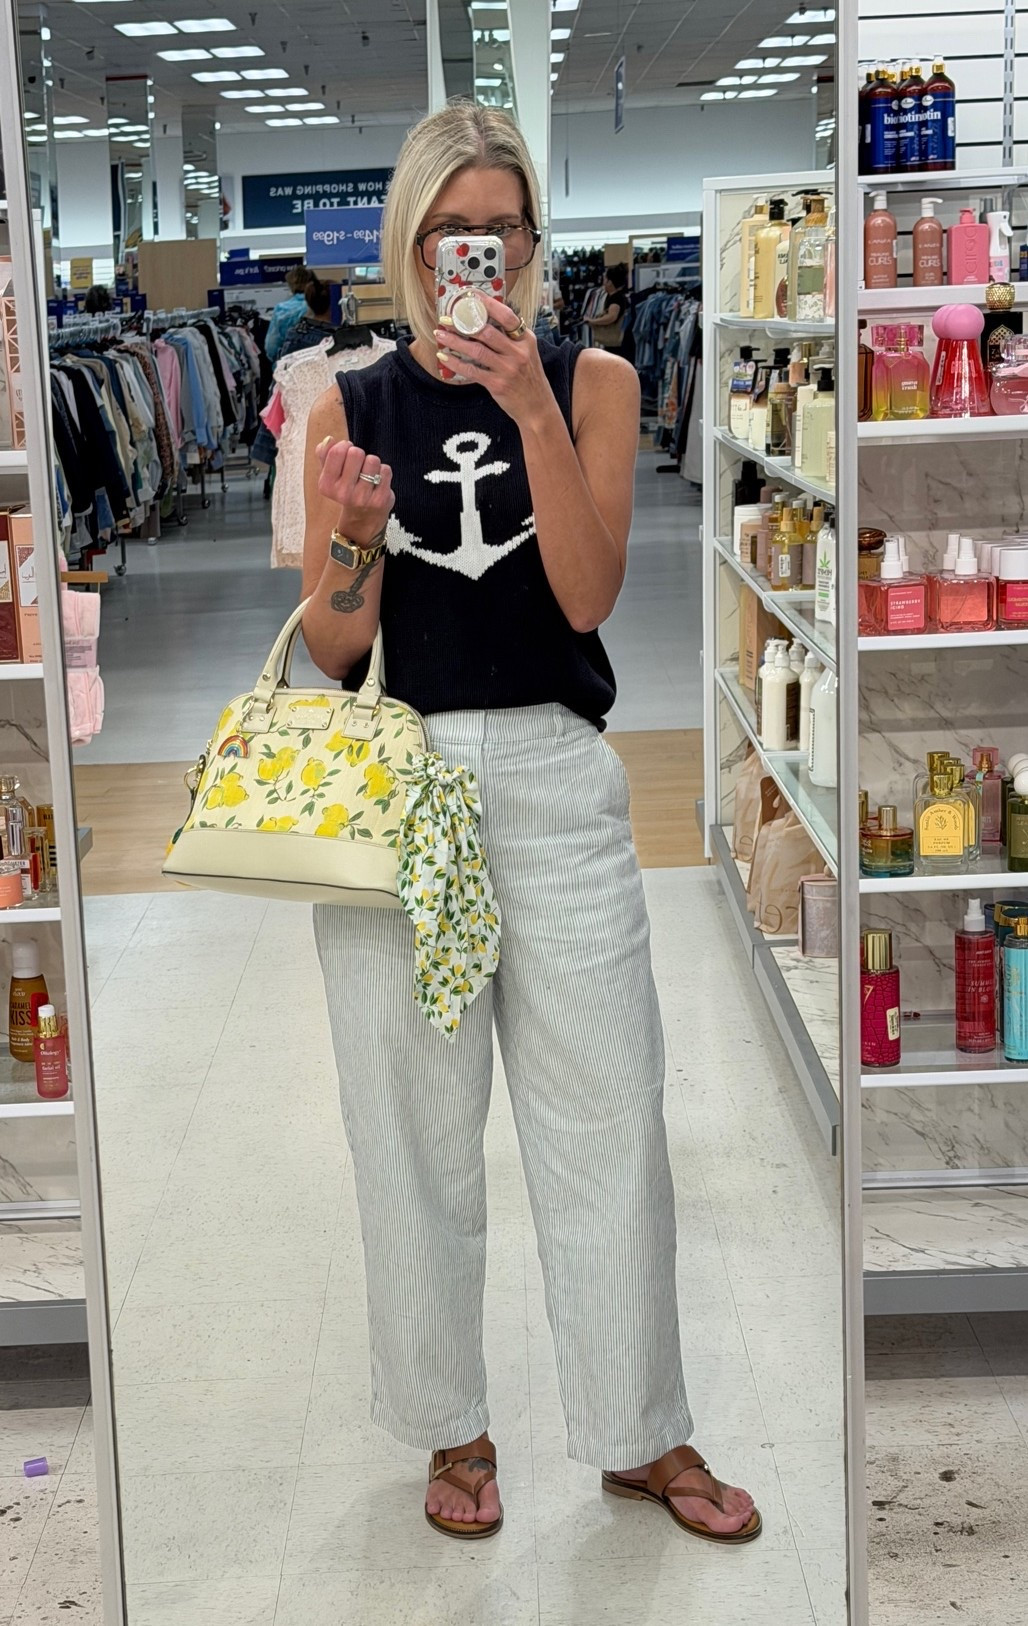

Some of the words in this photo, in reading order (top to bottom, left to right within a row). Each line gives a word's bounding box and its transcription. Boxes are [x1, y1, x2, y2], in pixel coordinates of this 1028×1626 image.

[868, 256, 892, 266] CURLS
[919, 259, 940, 268] CURLS
[10, 1010, 32, 1026] KISS
